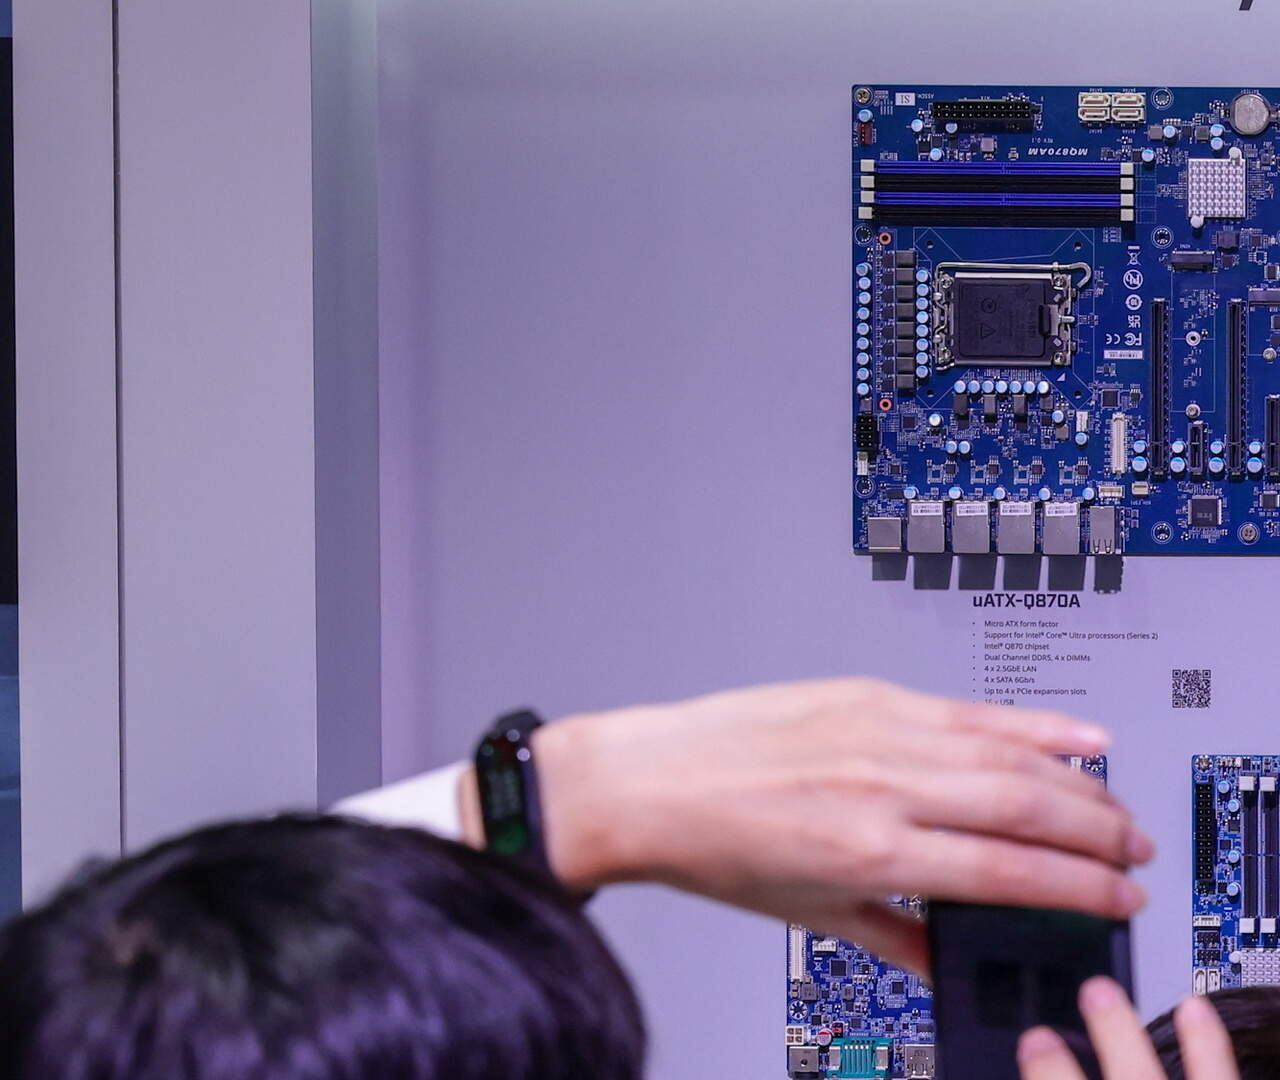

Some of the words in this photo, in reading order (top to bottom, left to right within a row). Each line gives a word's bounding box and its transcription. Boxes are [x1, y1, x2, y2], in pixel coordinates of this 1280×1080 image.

[973, 594, 1080, 609] uATX-Q870A
[984, 619, 1004, 627] Micro
[1005, 620, 1019, 628] ATX
[1020, 619, 1037, 627] form
[1038, 620, 1059, 628] factor
[984, 632, 1012, 640] Support
[1014, 631, 1024, 639] for
[1068, 631, 1086, 639] Ultra
[1087, 633, 1125, 641] processors
[1127, 632, 1150, 640] (Series
[984, 688, 995, 696] Up
[996, 687, 1003, 695] to
[1016, 687, 1032, 695] PCIe
[1033, 688, 1069, 696] expansion
[1070, 687, 1086, 695] slots
